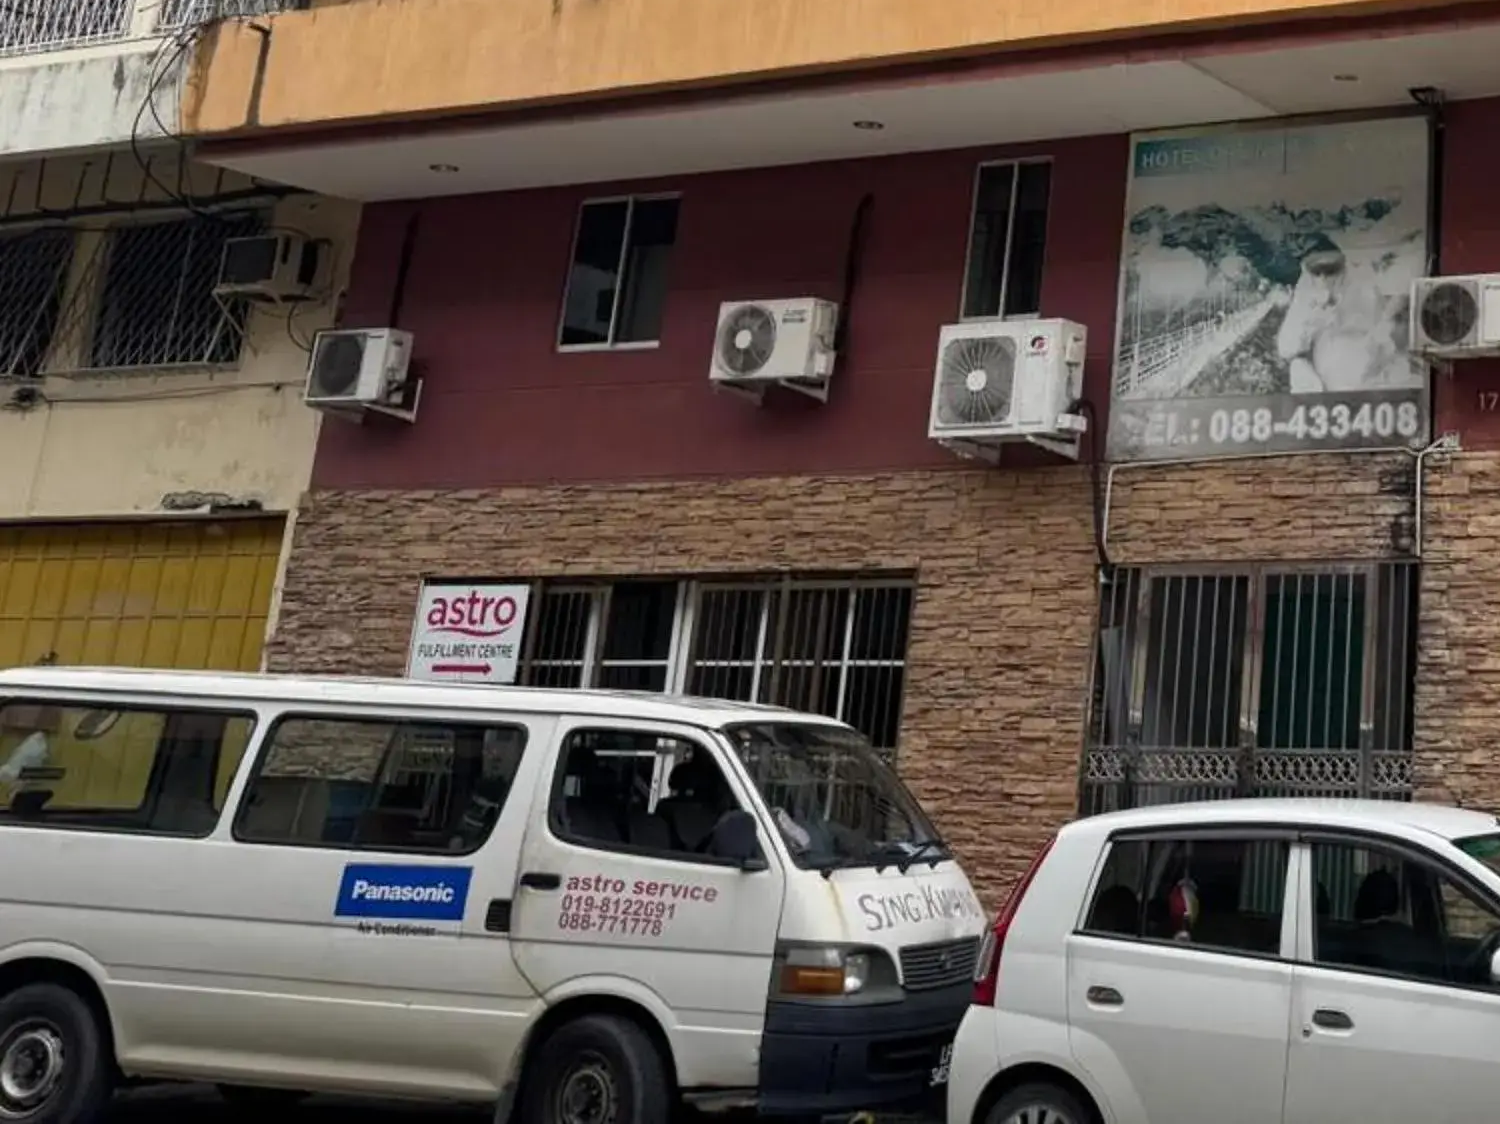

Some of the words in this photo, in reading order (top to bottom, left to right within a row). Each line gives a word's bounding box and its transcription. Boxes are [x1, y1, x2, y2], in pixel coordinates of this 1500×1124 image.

[1479, 391, 1499, 412] 17
[1208, 401, 1418, 444] 088-433408
[427, 590, 517, 626] astro
[418, 643, 476, 658] FULFILLMENT
[479, 643, 514, 658] CENTRE
[351, 879, 455, 903] Panasonic
[566, 874, 626, 893] astro
[632, 879, 719, 902] service
[558, 912, 664, 937] 088-771778
